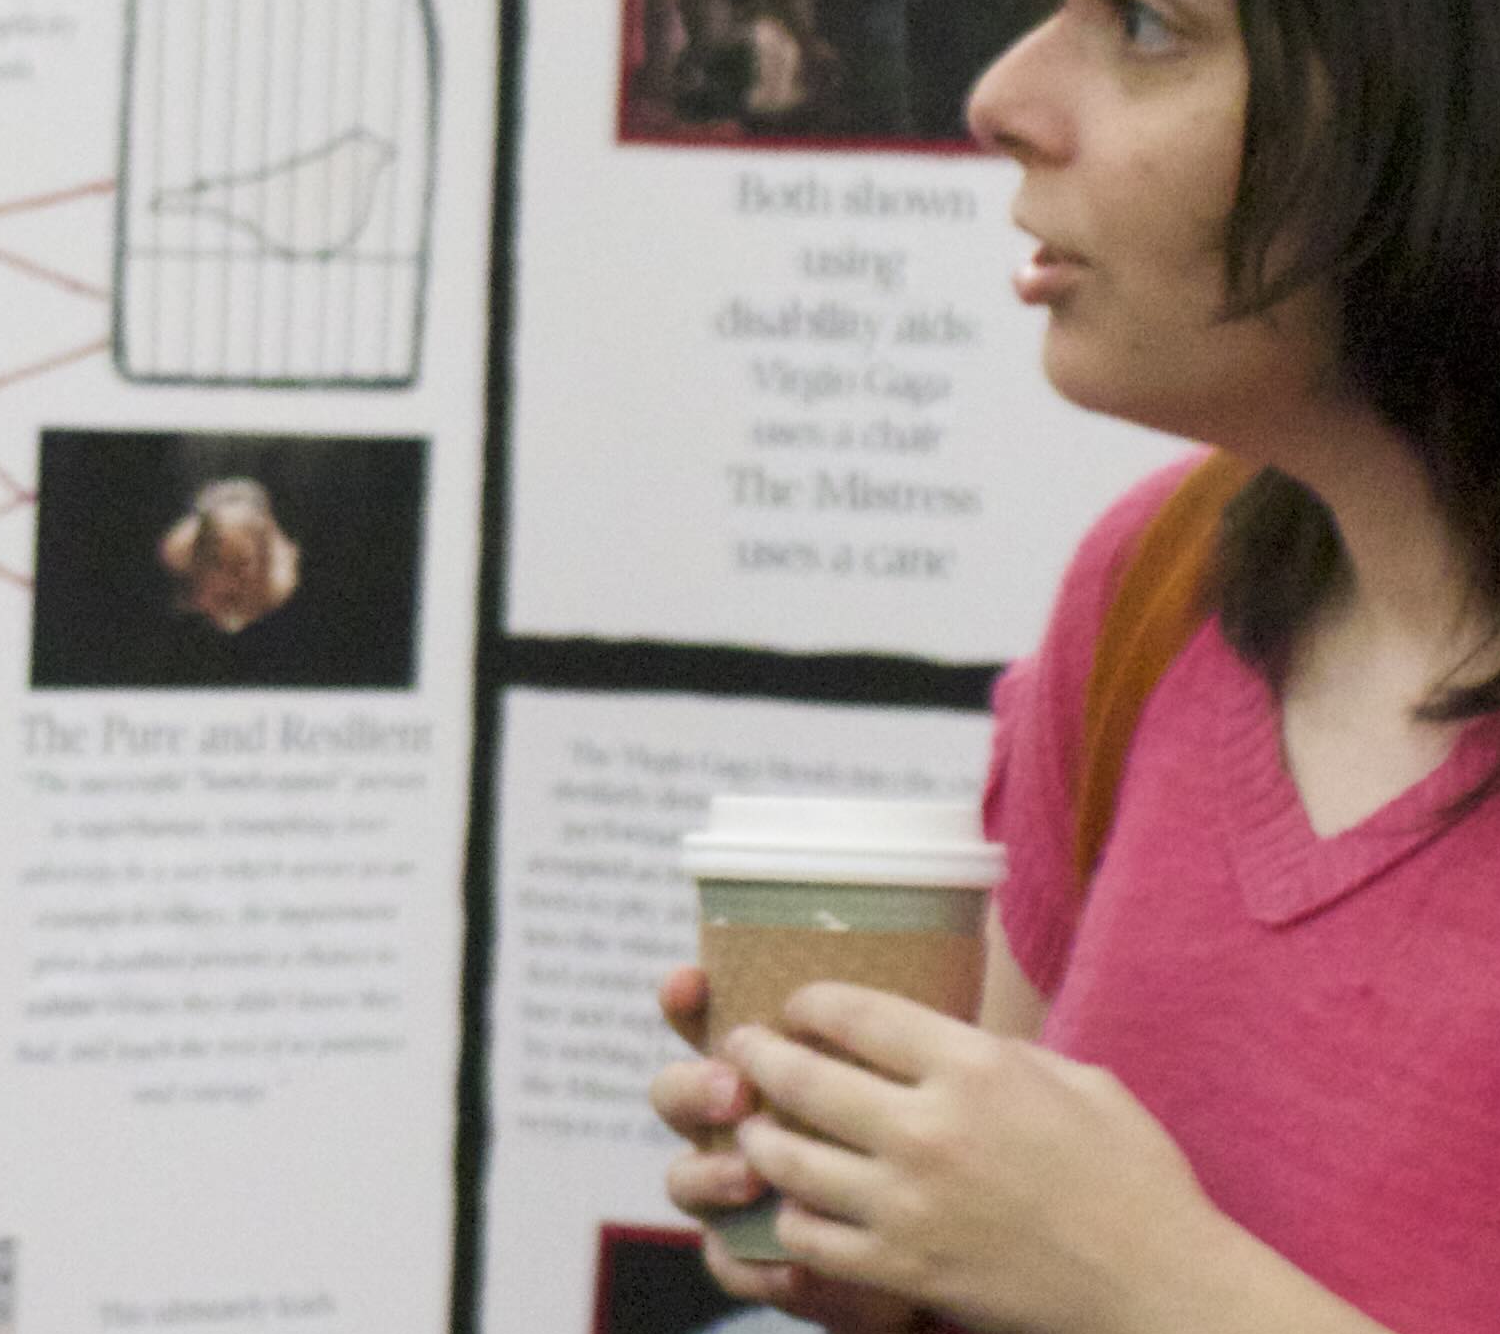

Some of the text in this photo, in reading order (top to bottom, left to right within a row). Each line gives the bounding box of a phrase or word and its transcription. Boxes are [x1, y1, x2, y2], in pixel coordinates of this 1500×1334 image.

[736, 174, 977, 221] Both shown
[799, 244, 905, 294] using
[726, 464, 798, 509] The
[20, 711, 434, 756] The Pure and Resilient
